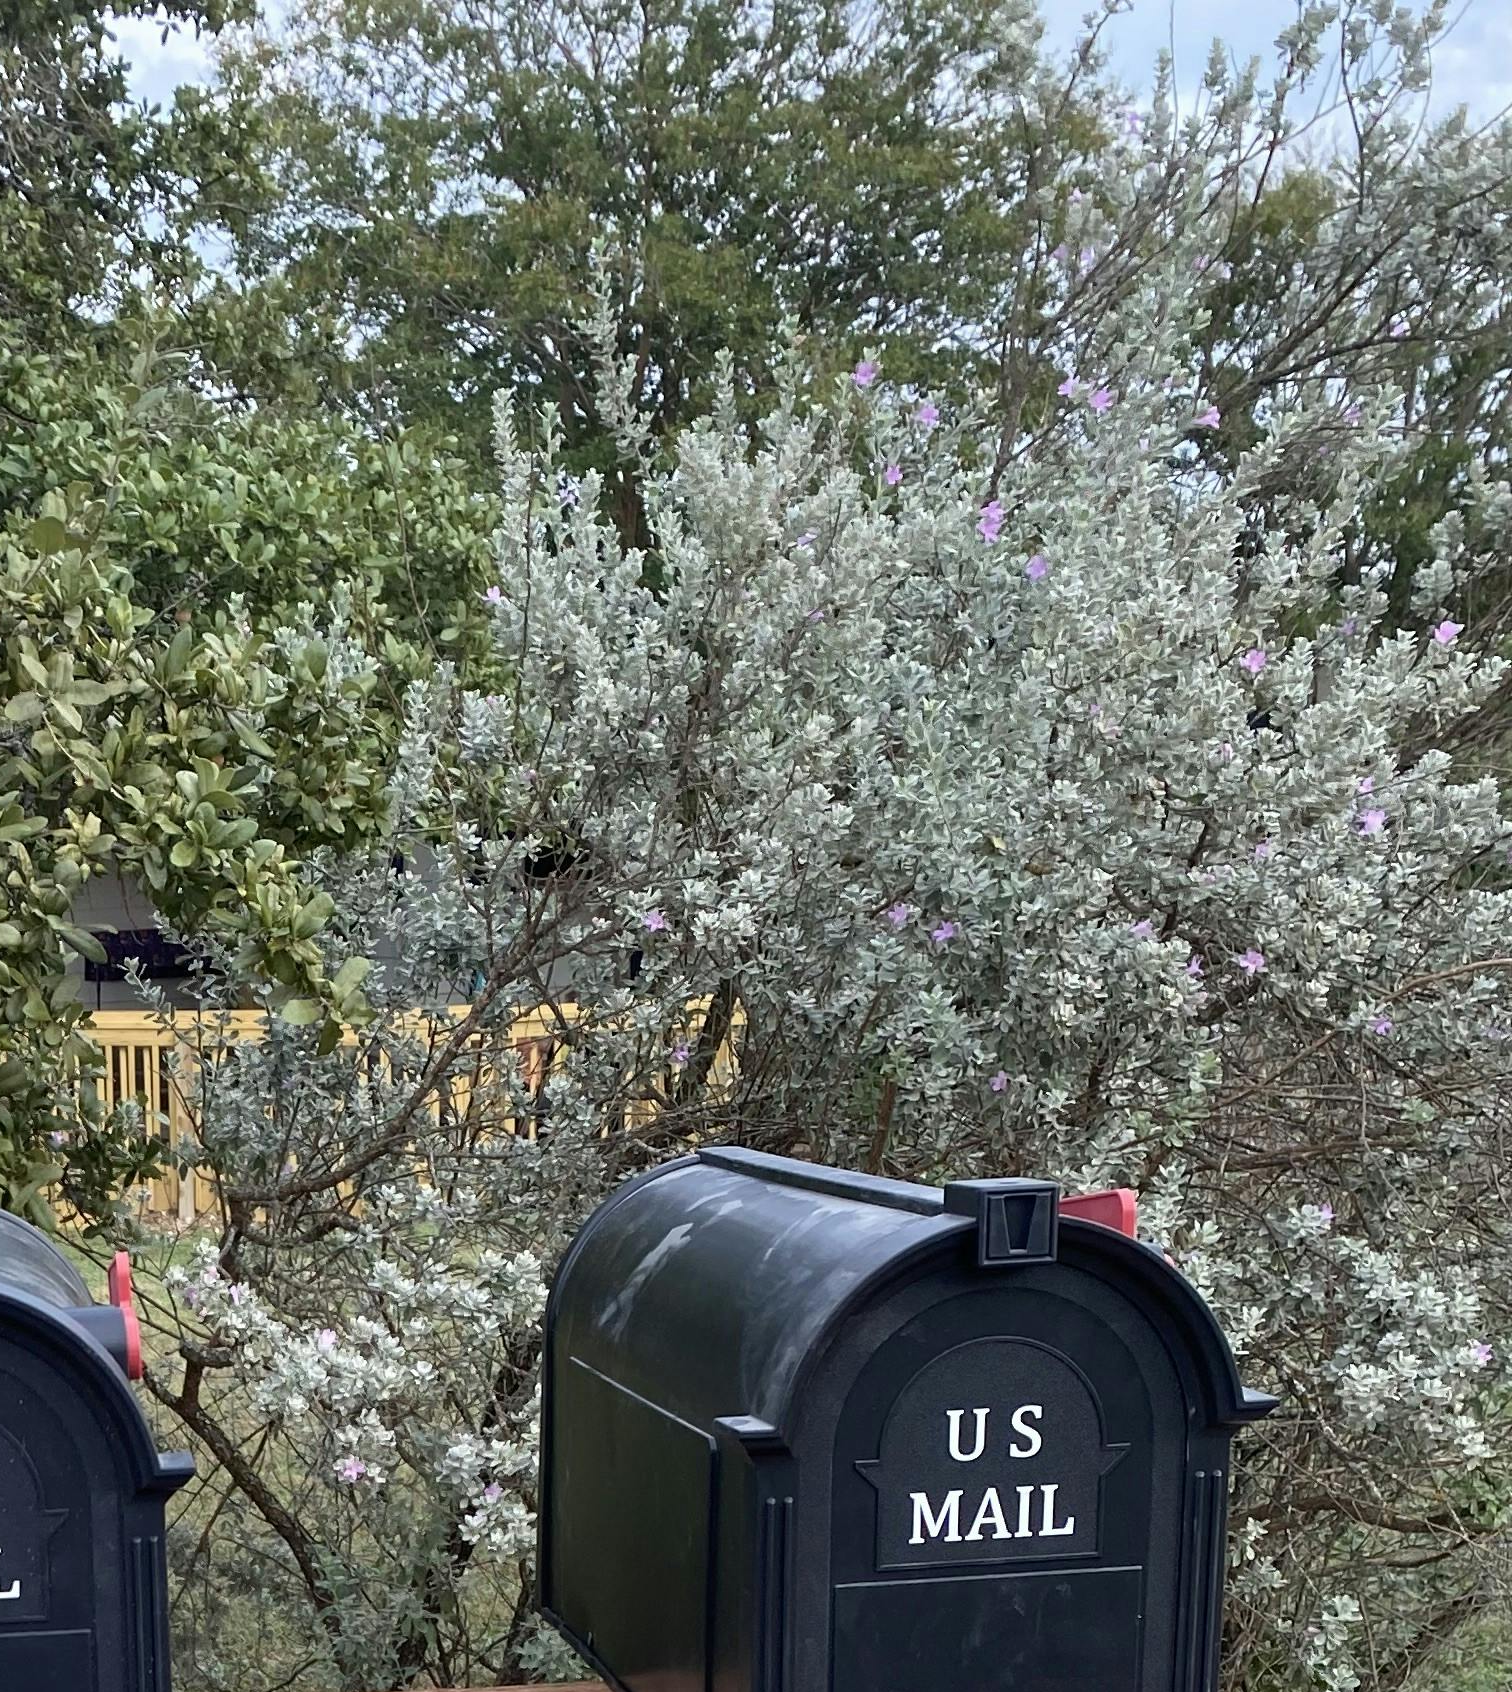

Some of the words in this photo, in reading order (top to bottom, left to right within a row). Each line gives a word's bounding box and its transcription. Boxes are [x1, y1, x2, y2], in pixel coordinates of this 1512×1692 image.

[946, 1407, 990, 1461] U
[1009, 1404, 1043, 1458] S
[908, 1484, 1074, 1544] MAIL
